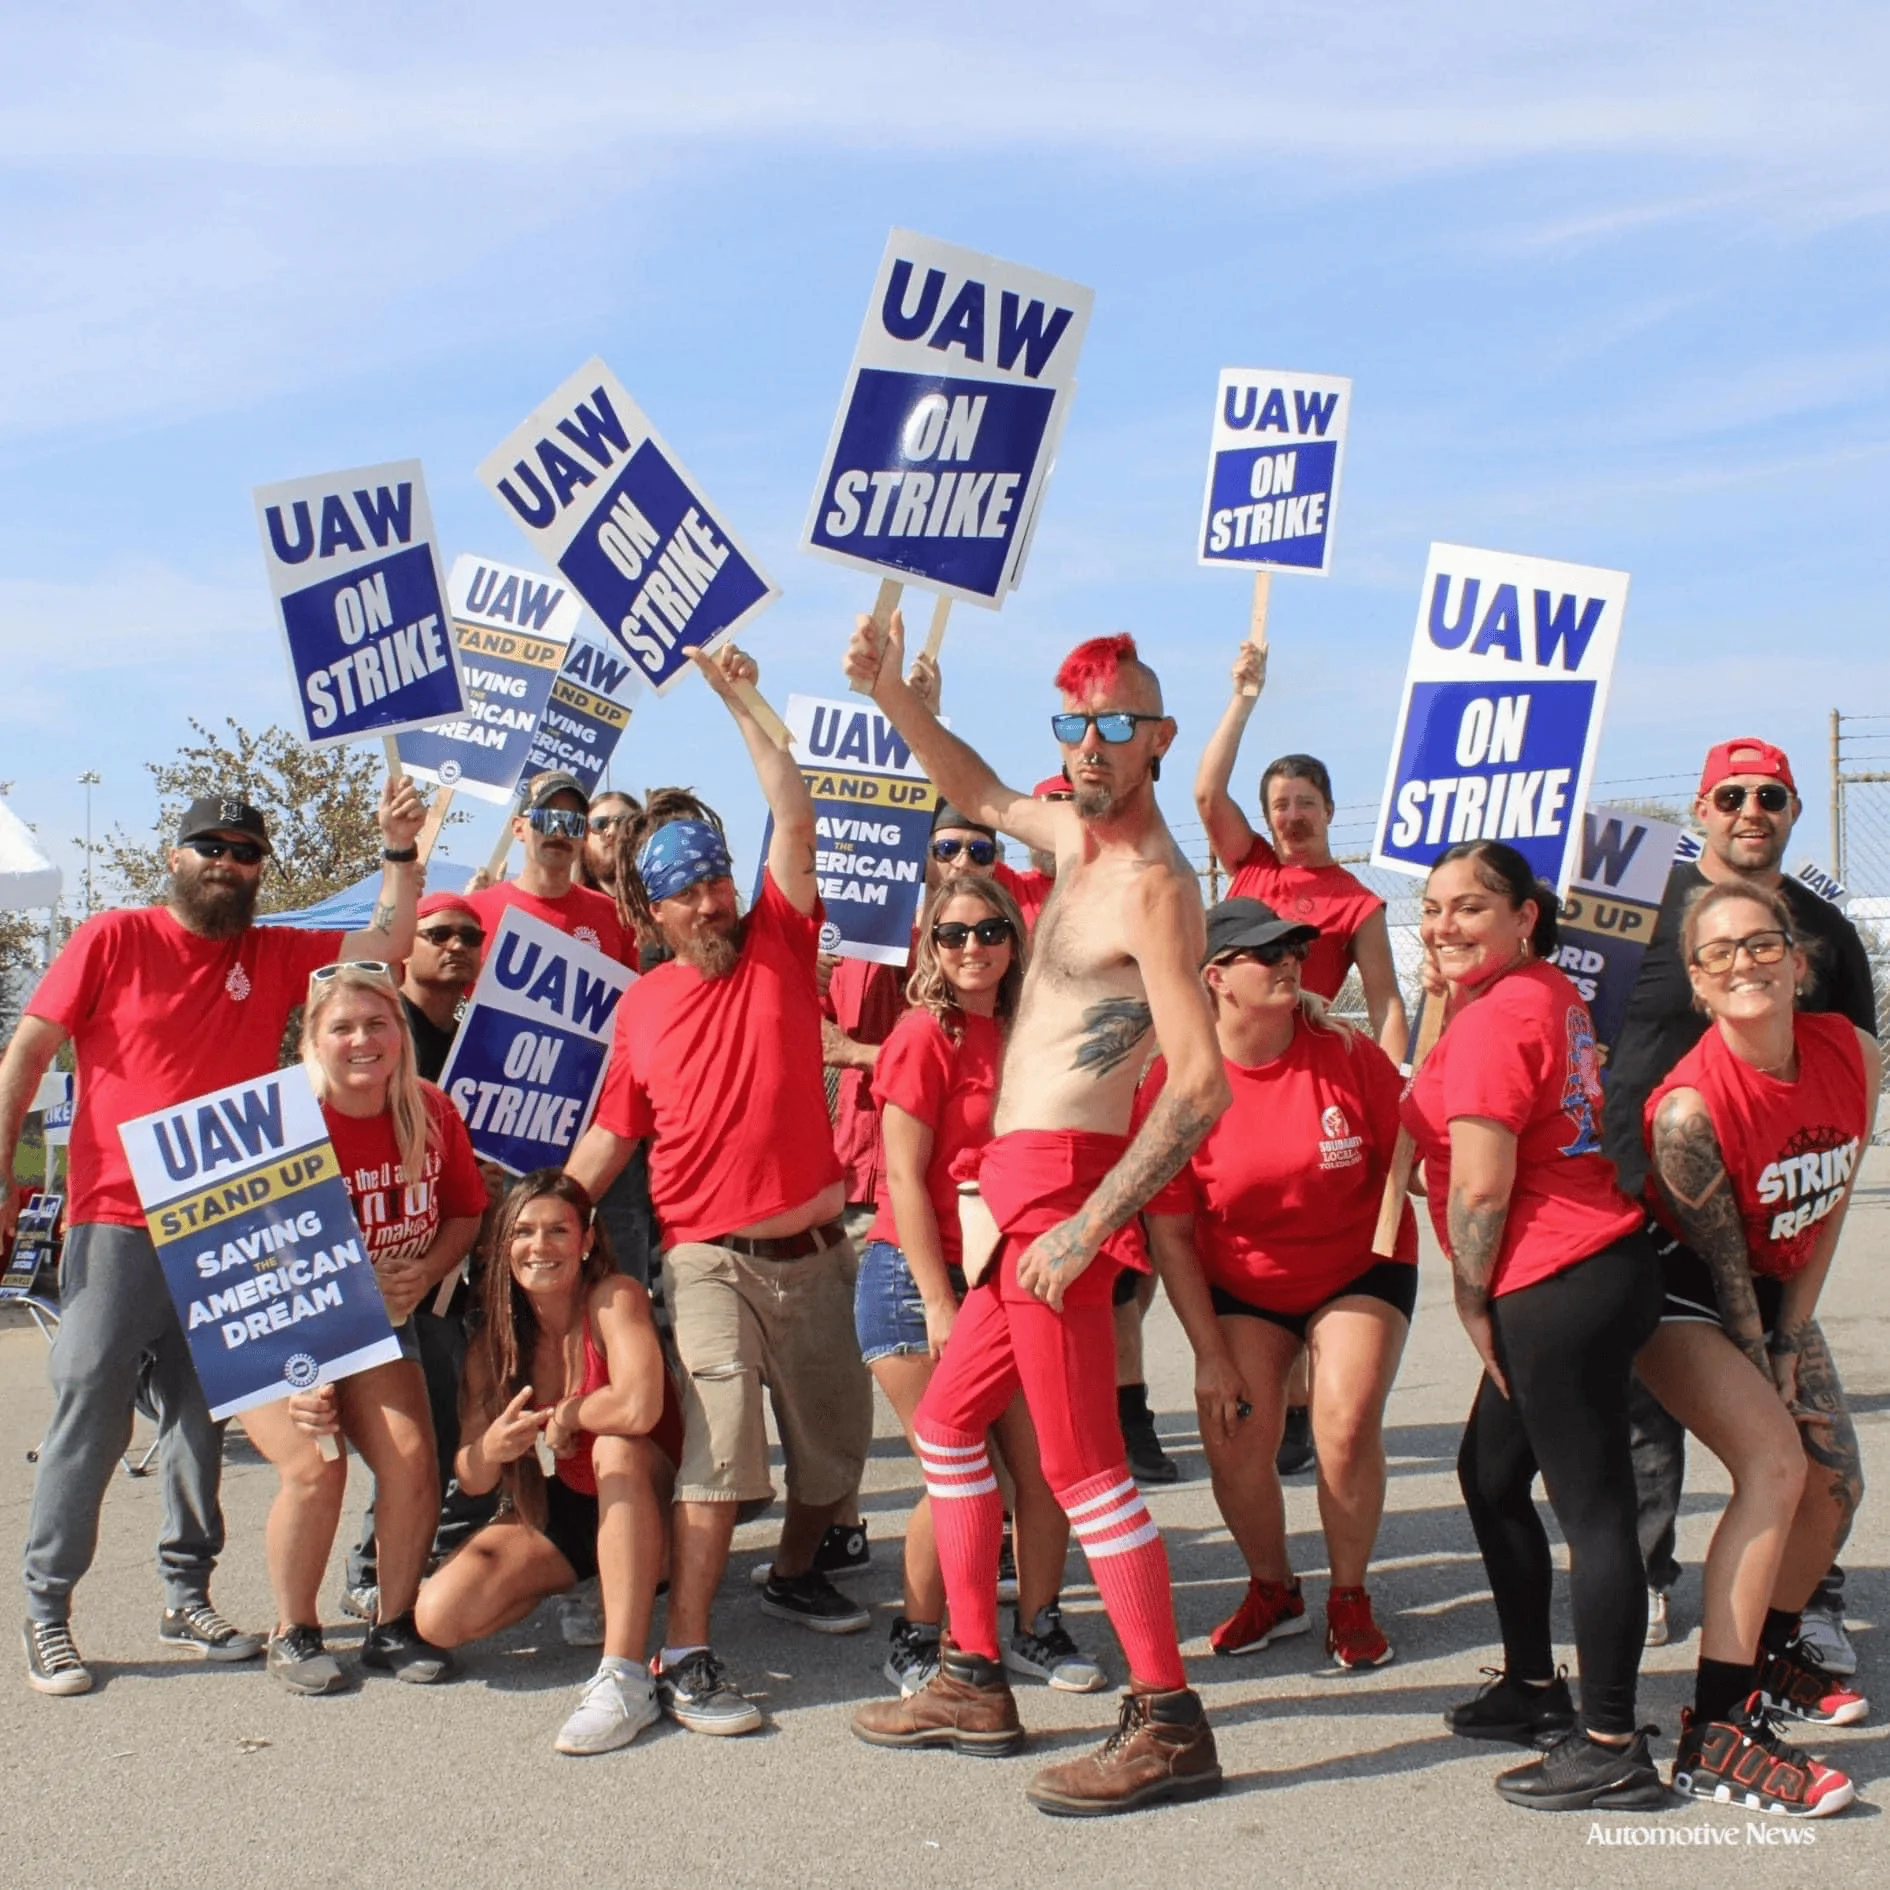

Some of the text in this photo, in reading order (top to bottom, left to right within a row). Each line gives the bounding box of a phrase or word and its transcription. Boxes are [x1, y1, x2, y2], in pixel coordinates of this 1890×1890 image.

[882, 258, 1074, 379] UAW
[903, 393, 987, 462] ON
[1223, 385, 1339, 436] UAW
[496, 385, 631, 529] UAW
[1250, 451, 1297, 499] ON
[265, 482, 412, 564] UAW
[598, 491, 660, 581] ON
[825, 470, 1021, 538] STRIKE
[1210, 492, 1326, 552] STRIKE
[334, 571, 394, 645] ON
[466, 566, 564, 631] UAW
[620, 506, 730, 672] STRIKE
[455, 627, 556, 663] TAND UP
[1428, 573, 1606, 672] UAW
[306, 613, 447, 728] STRIKE
[562, 638, 631, 695] AW
[594, 705, 622, 721] UP
[809, 706, 912, 770] UAW
[1455, 694, 1531, 768] ON
[533, 732, 603, 773] ERICAN
[803, 775, 927, 805] TAND UP
[1391, 767, 1571, 848] STRIKE
[815, 816, 901, 846] AVING
[834, 841, 854, 852] THE
[815, 850, 918, 882] ERICAN
[816, 878, 888, 905] REAM
[1800, 864, 1845, 900] UAW
[1594, 904, 1643, 933] UP
[495, 931, 623, 1034] UAW
[503, 1031, 565, 1085] ON
[153, 1082, 285, 1182] UAW
[450, 1077, 582, 1146] STRIKE
[160, 1176, 271, 1236] STAND
[279, 1154, 325, 1187] UP
[355, 1167, 379, 1192] the
[196, 1210, 322, 1278] SAVING
[253, 1255, 278, 1272] THE
[188, 1239, 361, 1330] AMERICAN
[222, 1281, 343, 1350] DREAM
